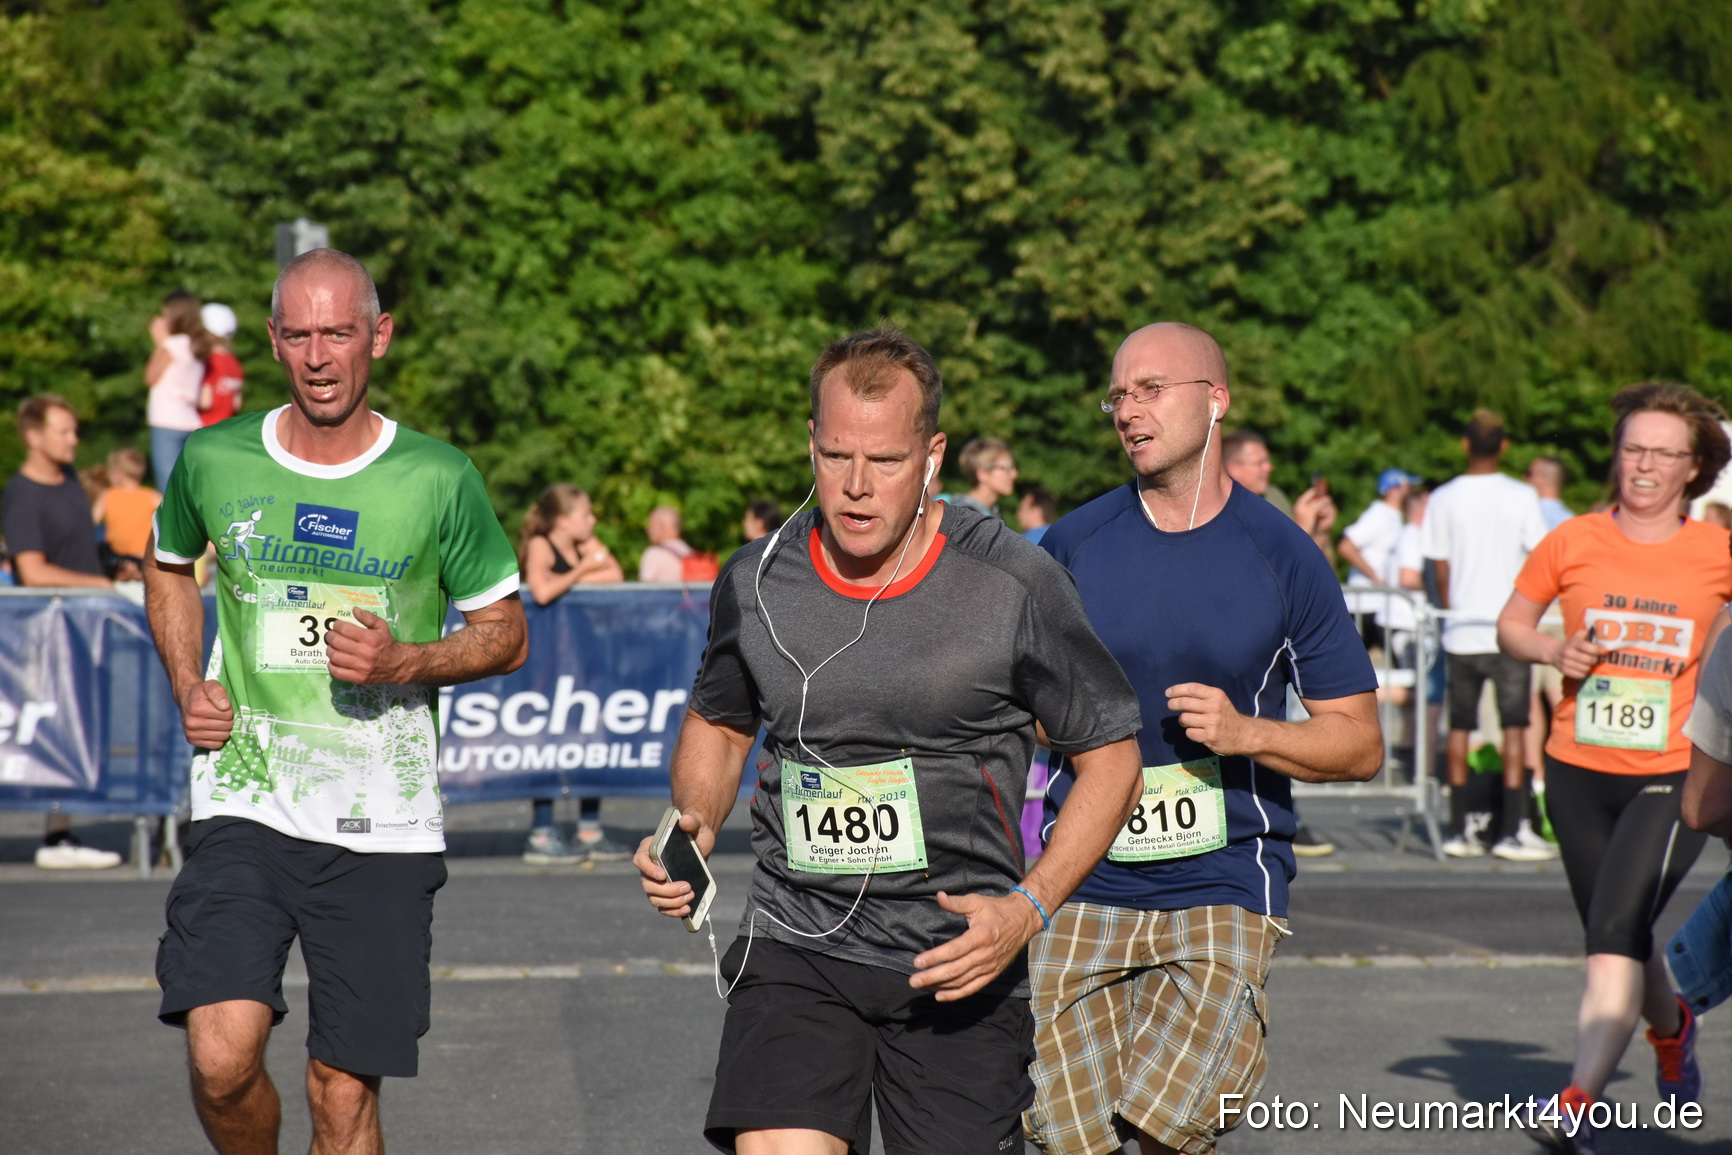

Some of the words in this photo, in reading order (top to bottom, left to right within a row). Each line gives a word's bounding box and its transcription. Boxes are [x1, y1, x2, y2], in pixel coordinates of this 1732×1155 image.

[219, 501, 234, 518] 10
[308, 521, 353, 536] Fischer
[311, 531, 348, 541] AUTOMOBILE
[260, 535, 414, 580] firmenlauf
[260, 563, 325, 577] neumarkt
[277, 597, 327, 610] firmenlauf
[1603, 594, 1627, 609] 30
[1631, 597, 1678, 614] Jahre
[1594, 619, 1684, 647] OBI
[290, 648, 323, 657] Barath
[295, 658, 311, 666] Auto
[1587, 700, 1655, 729] 1189
[795, 784, 843, 799] firmenlauf
[880, 790, 906, 802] 2019
[796, 803, 899, 843] 1480
[1127, 797, 1197, 835] 810
[341, 820, 361, 830] AOK
[1127, 834, 1173, 846] Gerbeckx
[1176, 830, 1202, 843] Björn
[1158, 842, 1176, 850] Metall
[1177, 840, 1195, 848] GmbH
[810, 845, 844, 857] Geiger
[847, 845, 888, 855] Jochen
[818, 856, 839, 865] Egner
[868, 855, 893, 863] GmbH
